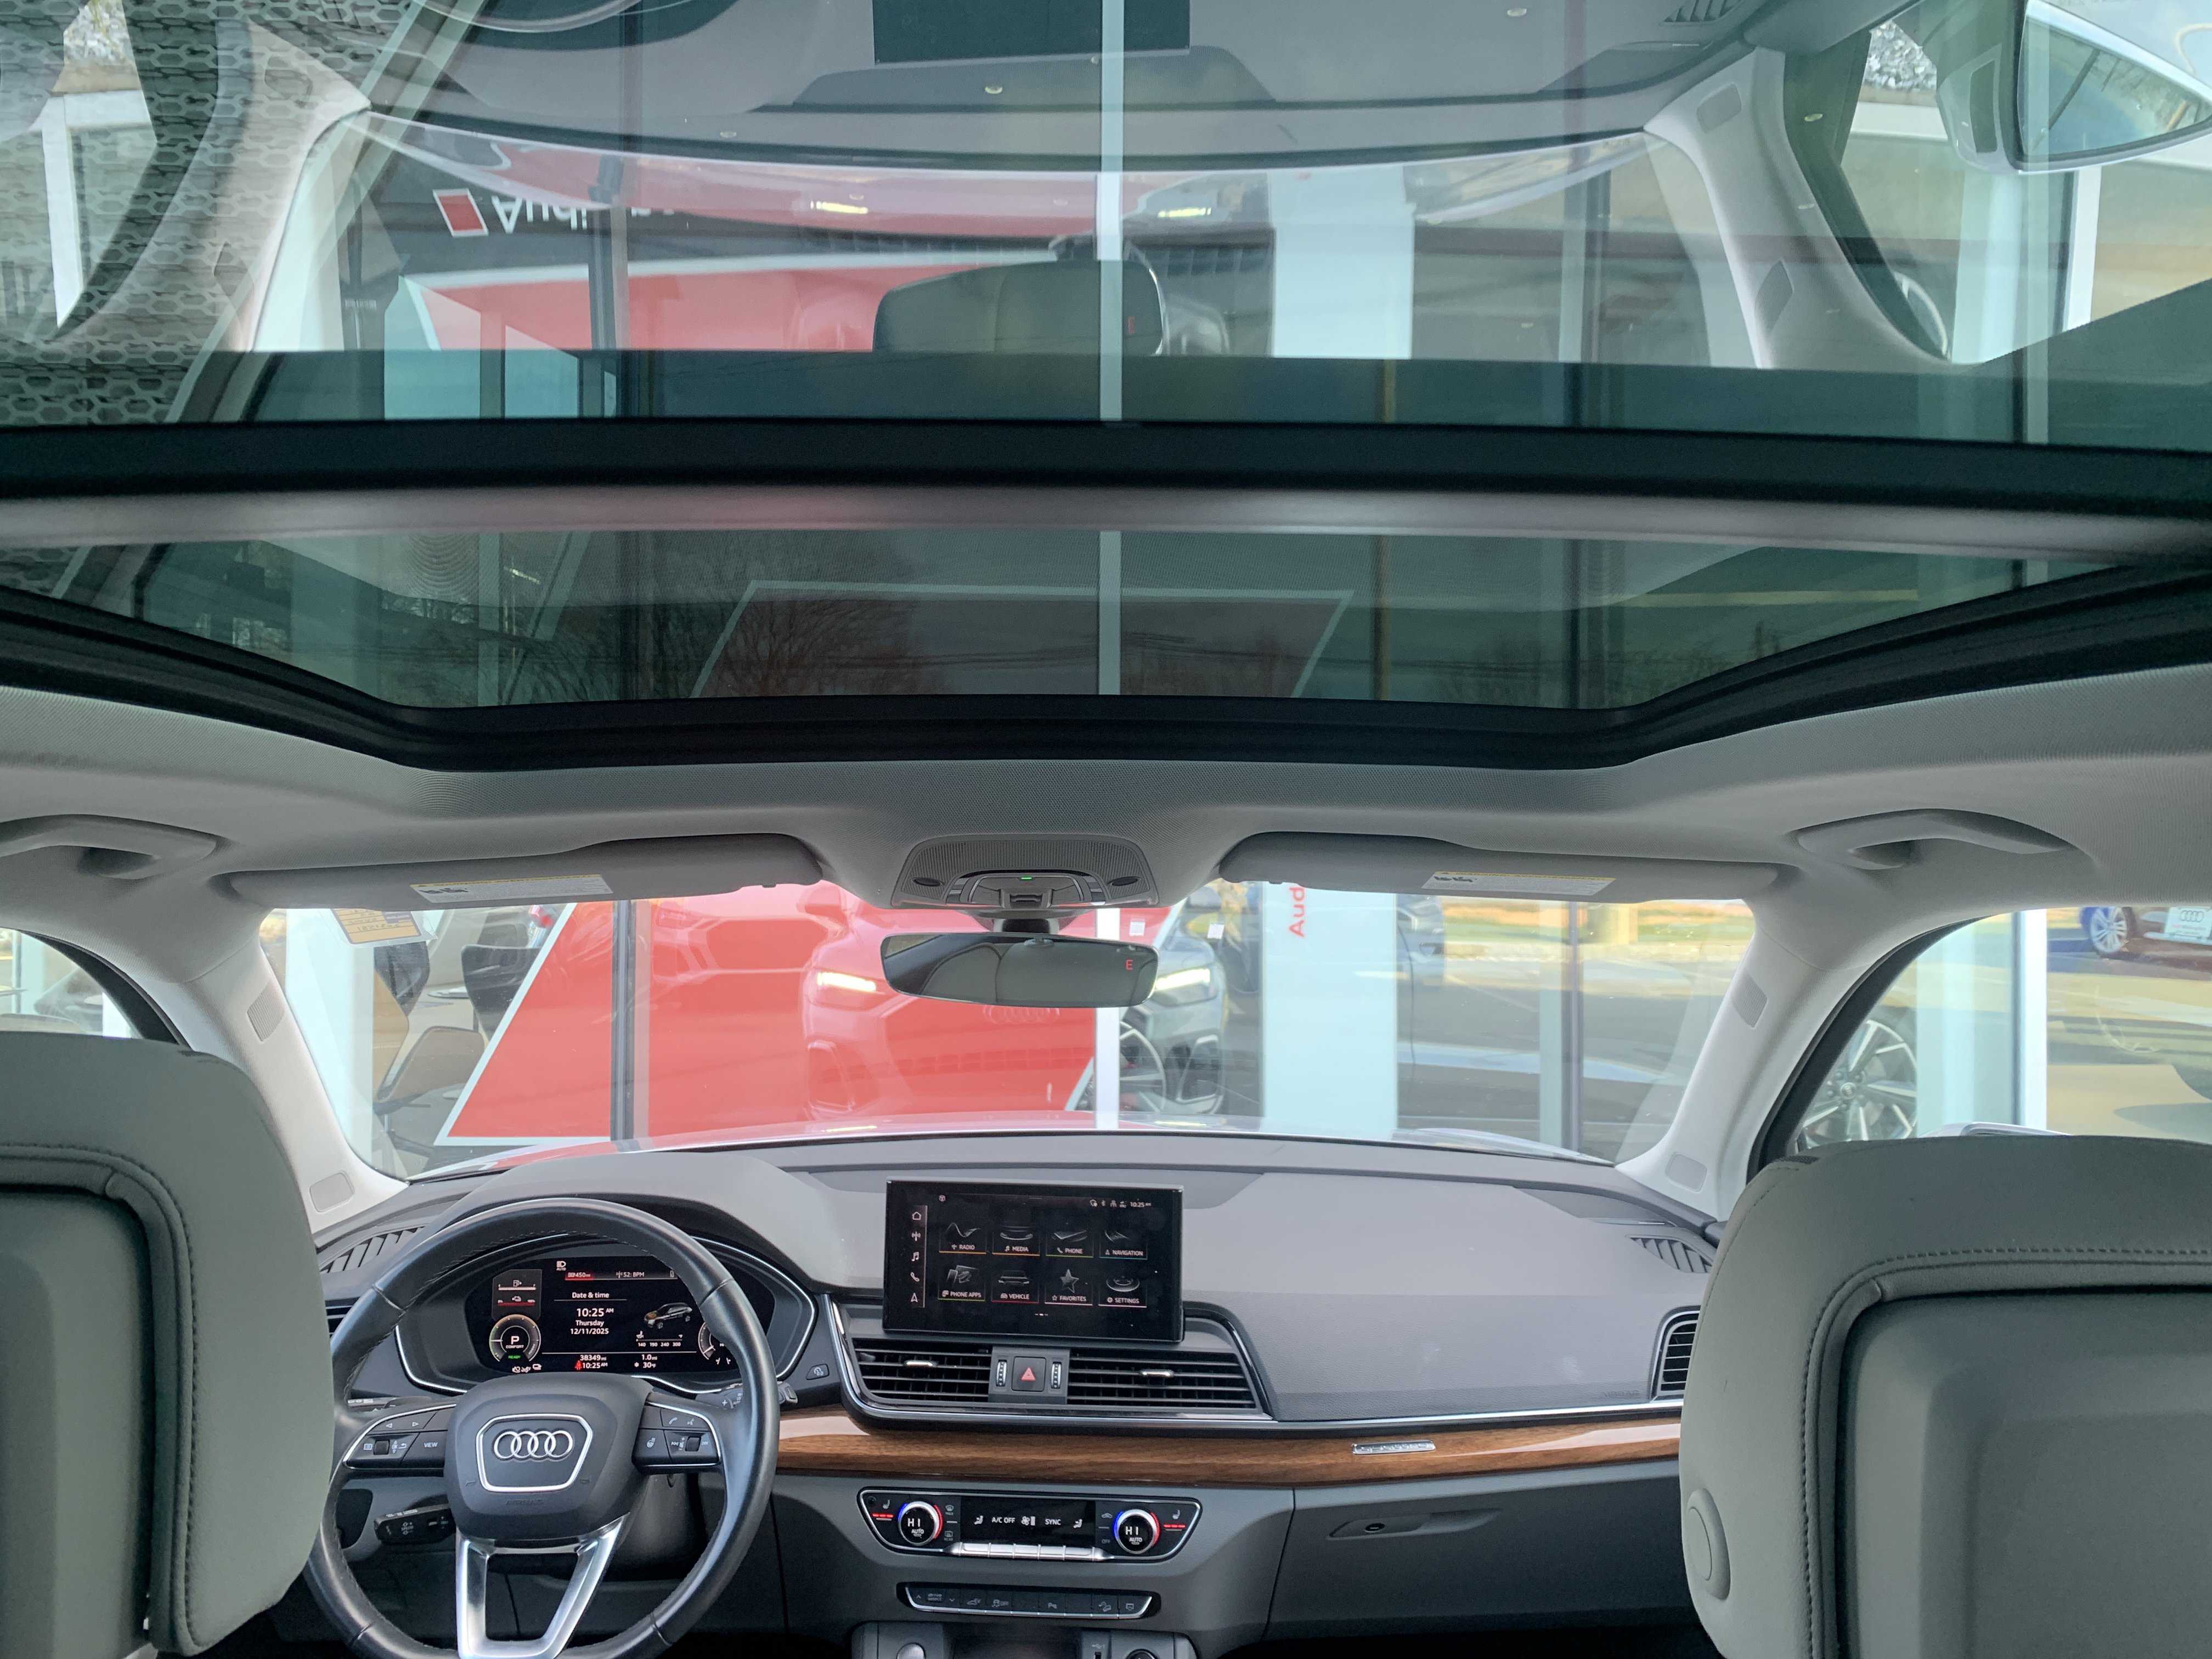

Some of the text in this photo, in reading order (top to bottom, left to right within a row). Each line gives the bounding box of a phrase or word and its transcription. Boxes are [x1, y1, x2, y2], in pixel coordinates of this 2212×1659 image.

[1125, 958, 1133, 970] E
[576, 1308, 604, 1317] 10:25
[511, 1336, 520, 1345] P
